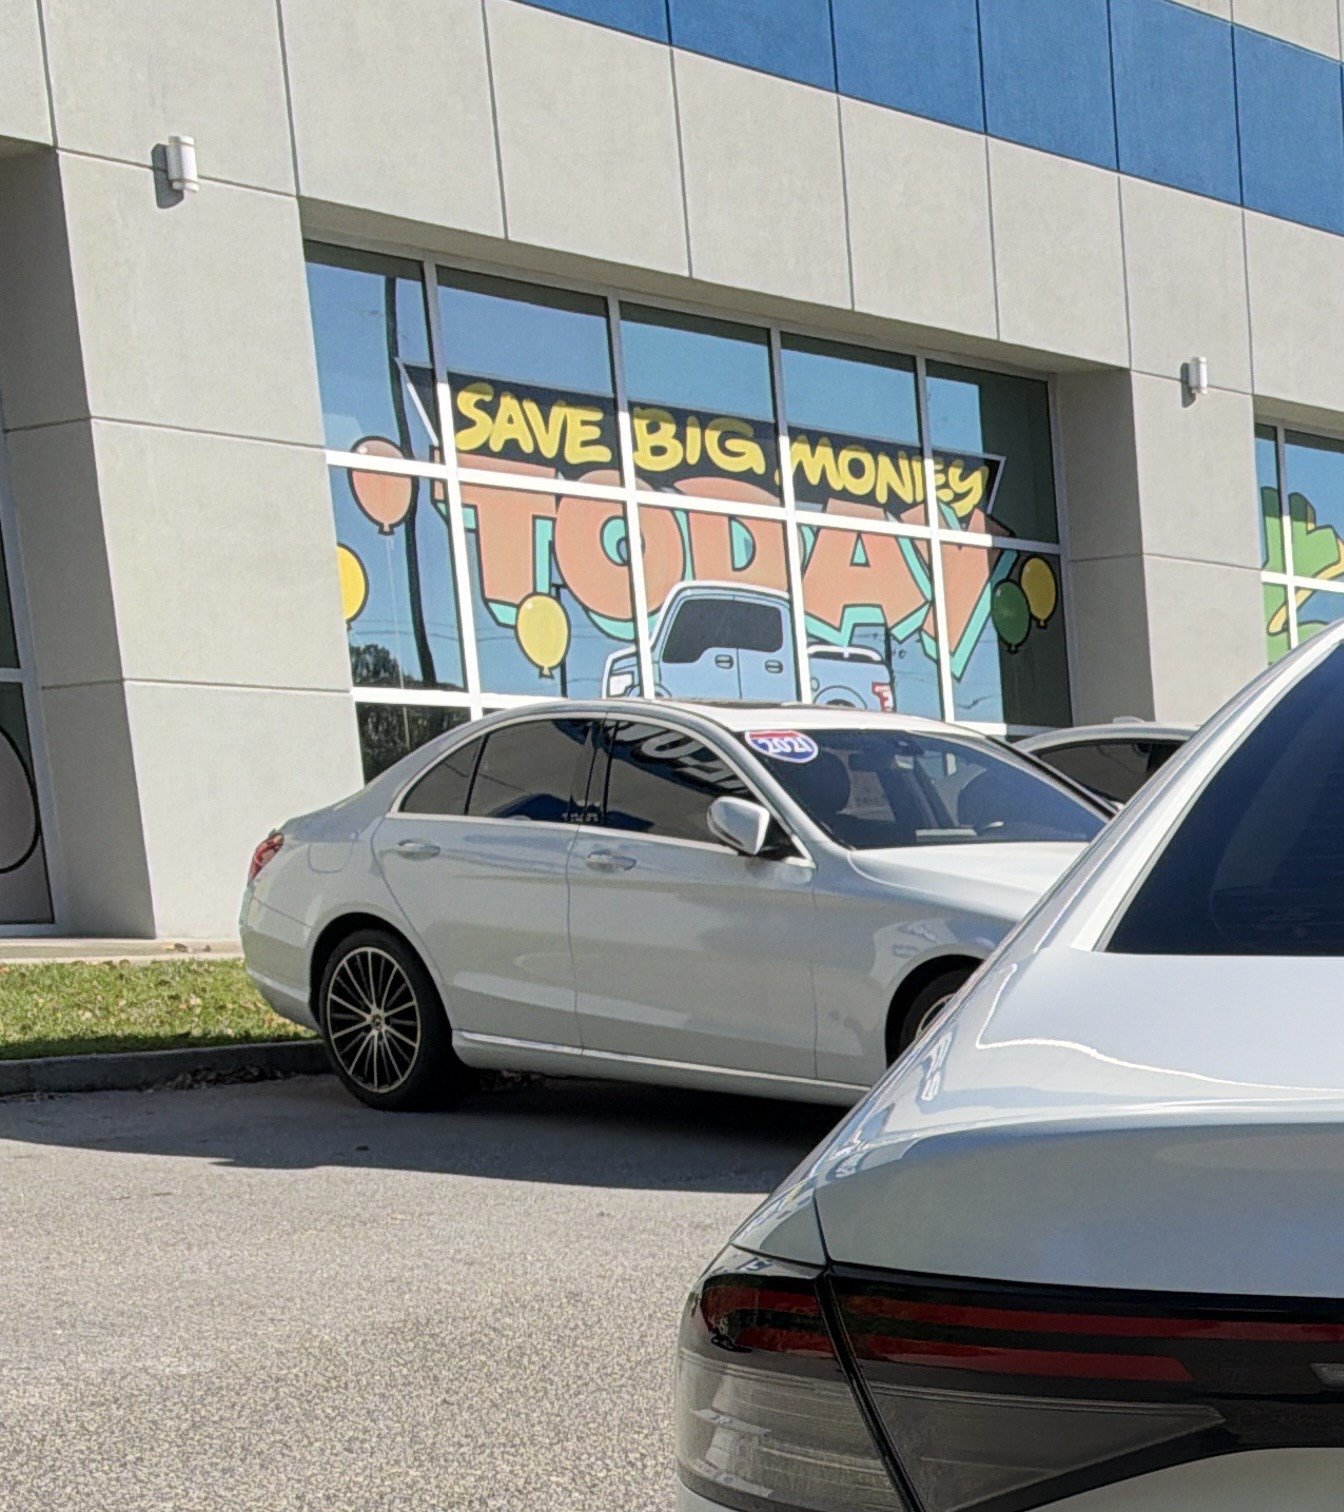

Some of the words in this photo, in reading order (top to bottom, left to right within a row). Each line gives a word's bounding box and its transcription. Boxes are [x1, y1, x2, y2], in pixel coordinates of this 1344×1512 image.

[454, 382, 612, 463] SAVE
[629, 407, 767, 476] BIG
[788, 439, 990, 517] MONEY
[434, 446, 1014, 680] TODAY
